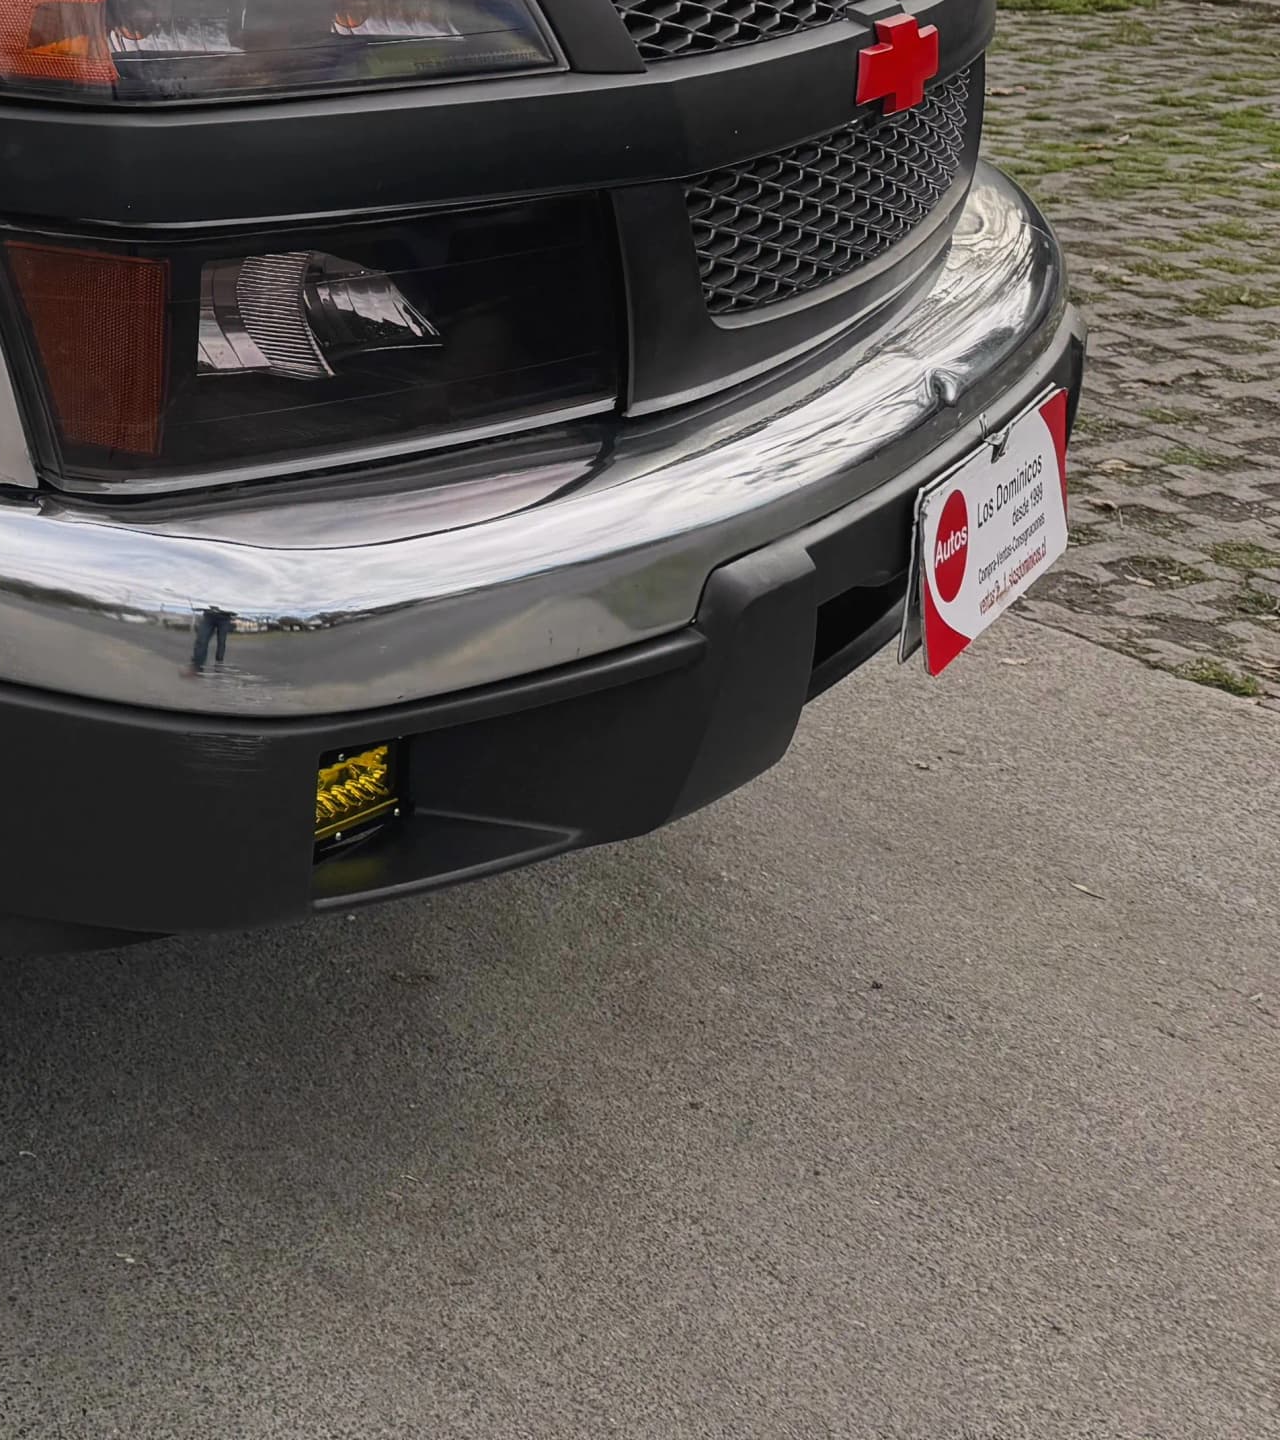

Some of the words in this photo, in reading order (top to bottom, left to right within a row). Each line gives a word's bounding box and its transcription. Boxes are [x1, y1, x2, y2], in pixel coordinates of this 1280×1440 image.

[977, 497, 994, 529] Los
[996, 455, 1042, 511] Dominicos
[1012, 497, 1029, 526] desde
[1030, 482, 1043, 507] 1999
[935, 526, 968, 568] Autos
